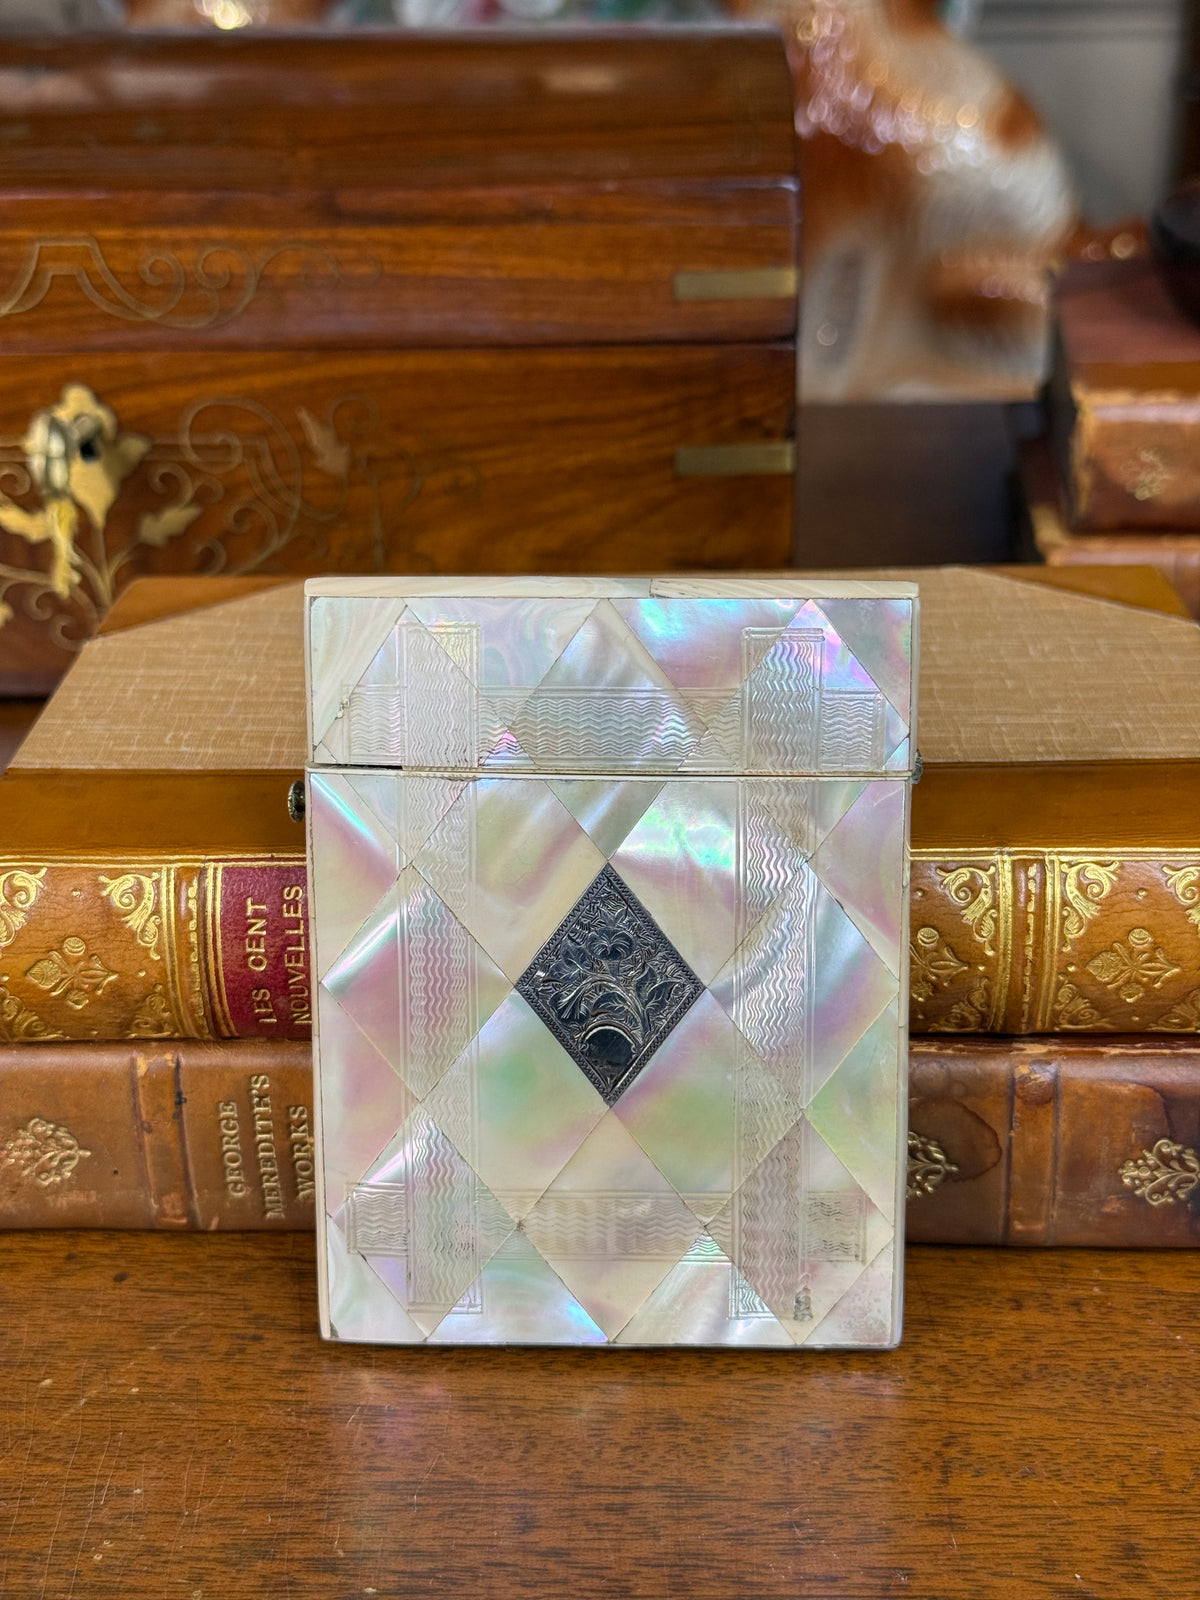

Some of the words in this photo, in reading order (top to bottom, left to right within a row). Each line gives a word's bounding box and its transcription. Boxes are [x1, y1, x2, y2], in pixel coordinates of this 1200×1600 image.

[246, 897, 267, 971] CENT
[283, 885, 312, 1024] NOUVELLES
[251, 988, 277, 1023] LES
[219, 1101, 246, 1197] GEORGE
[251, 1075, 285, 1219] MEREDITH'S
[289, 1106, 315, 1199] WORKS
